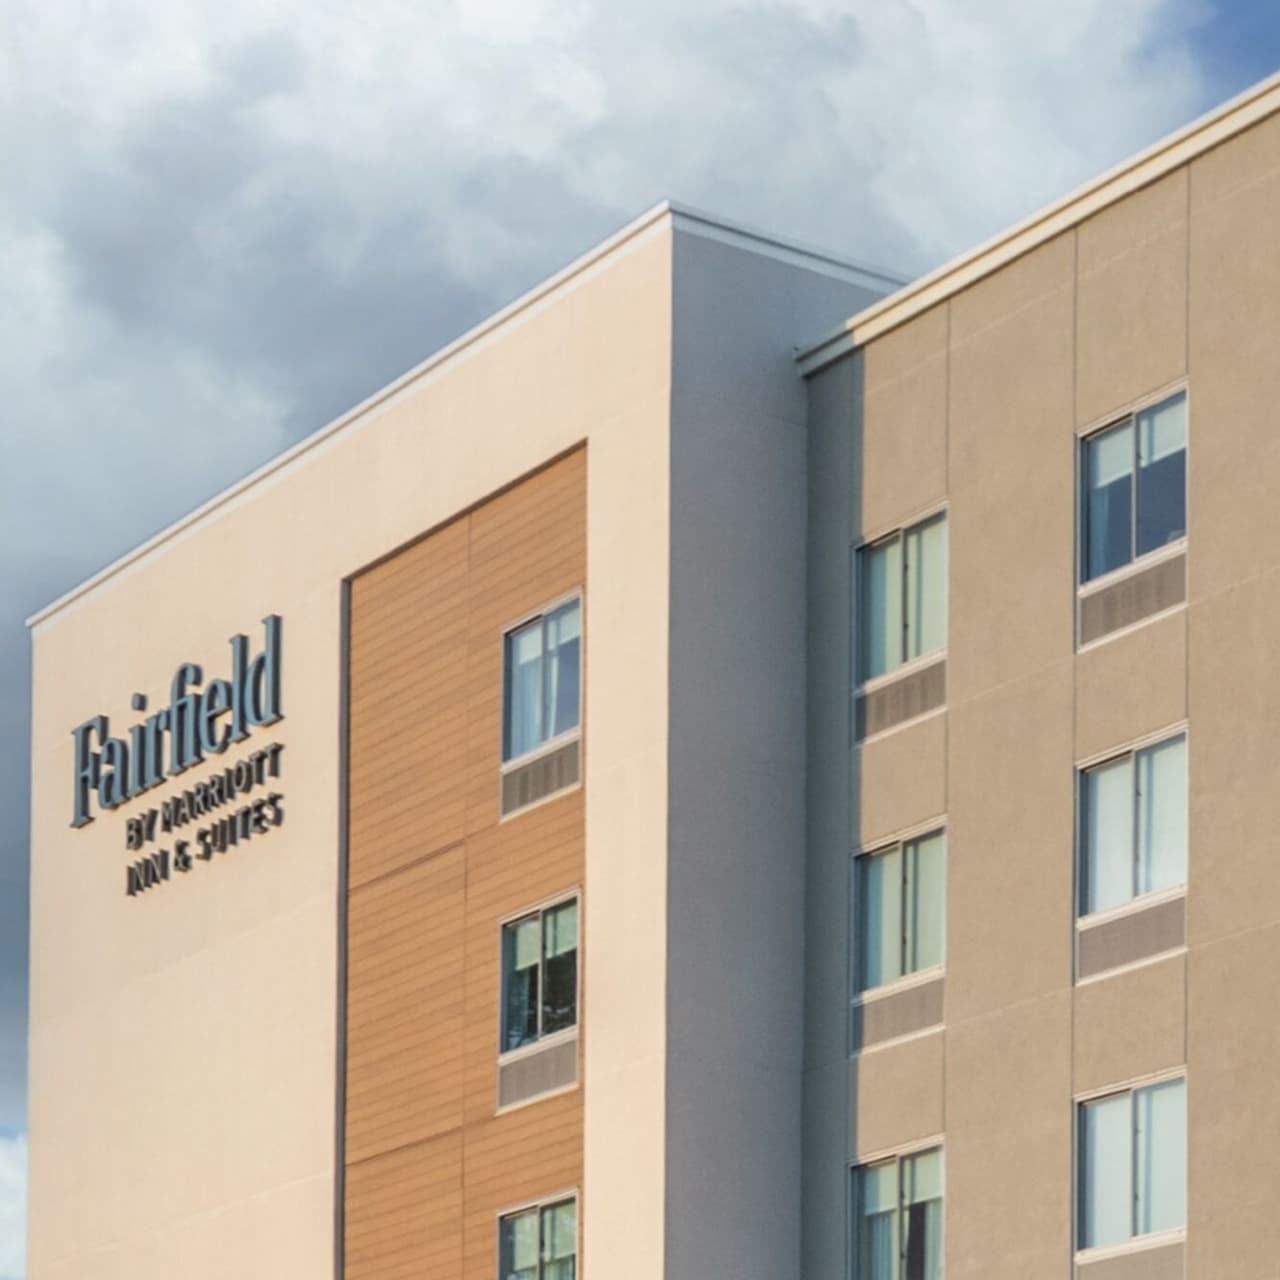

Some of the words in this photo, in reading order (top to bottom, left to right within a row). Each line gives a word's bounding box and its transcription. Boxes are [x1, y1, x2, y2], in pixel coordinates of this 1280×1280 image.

[70, 614, 285, 828] Fairfield
[126, 809, 158, 850] BY
[161, 742, 284, 833] MARRIOTT
[126, 849, 169, 896] INN
[174, 839, 192, 872] &
[195, 792, 284, 860] SUITES
